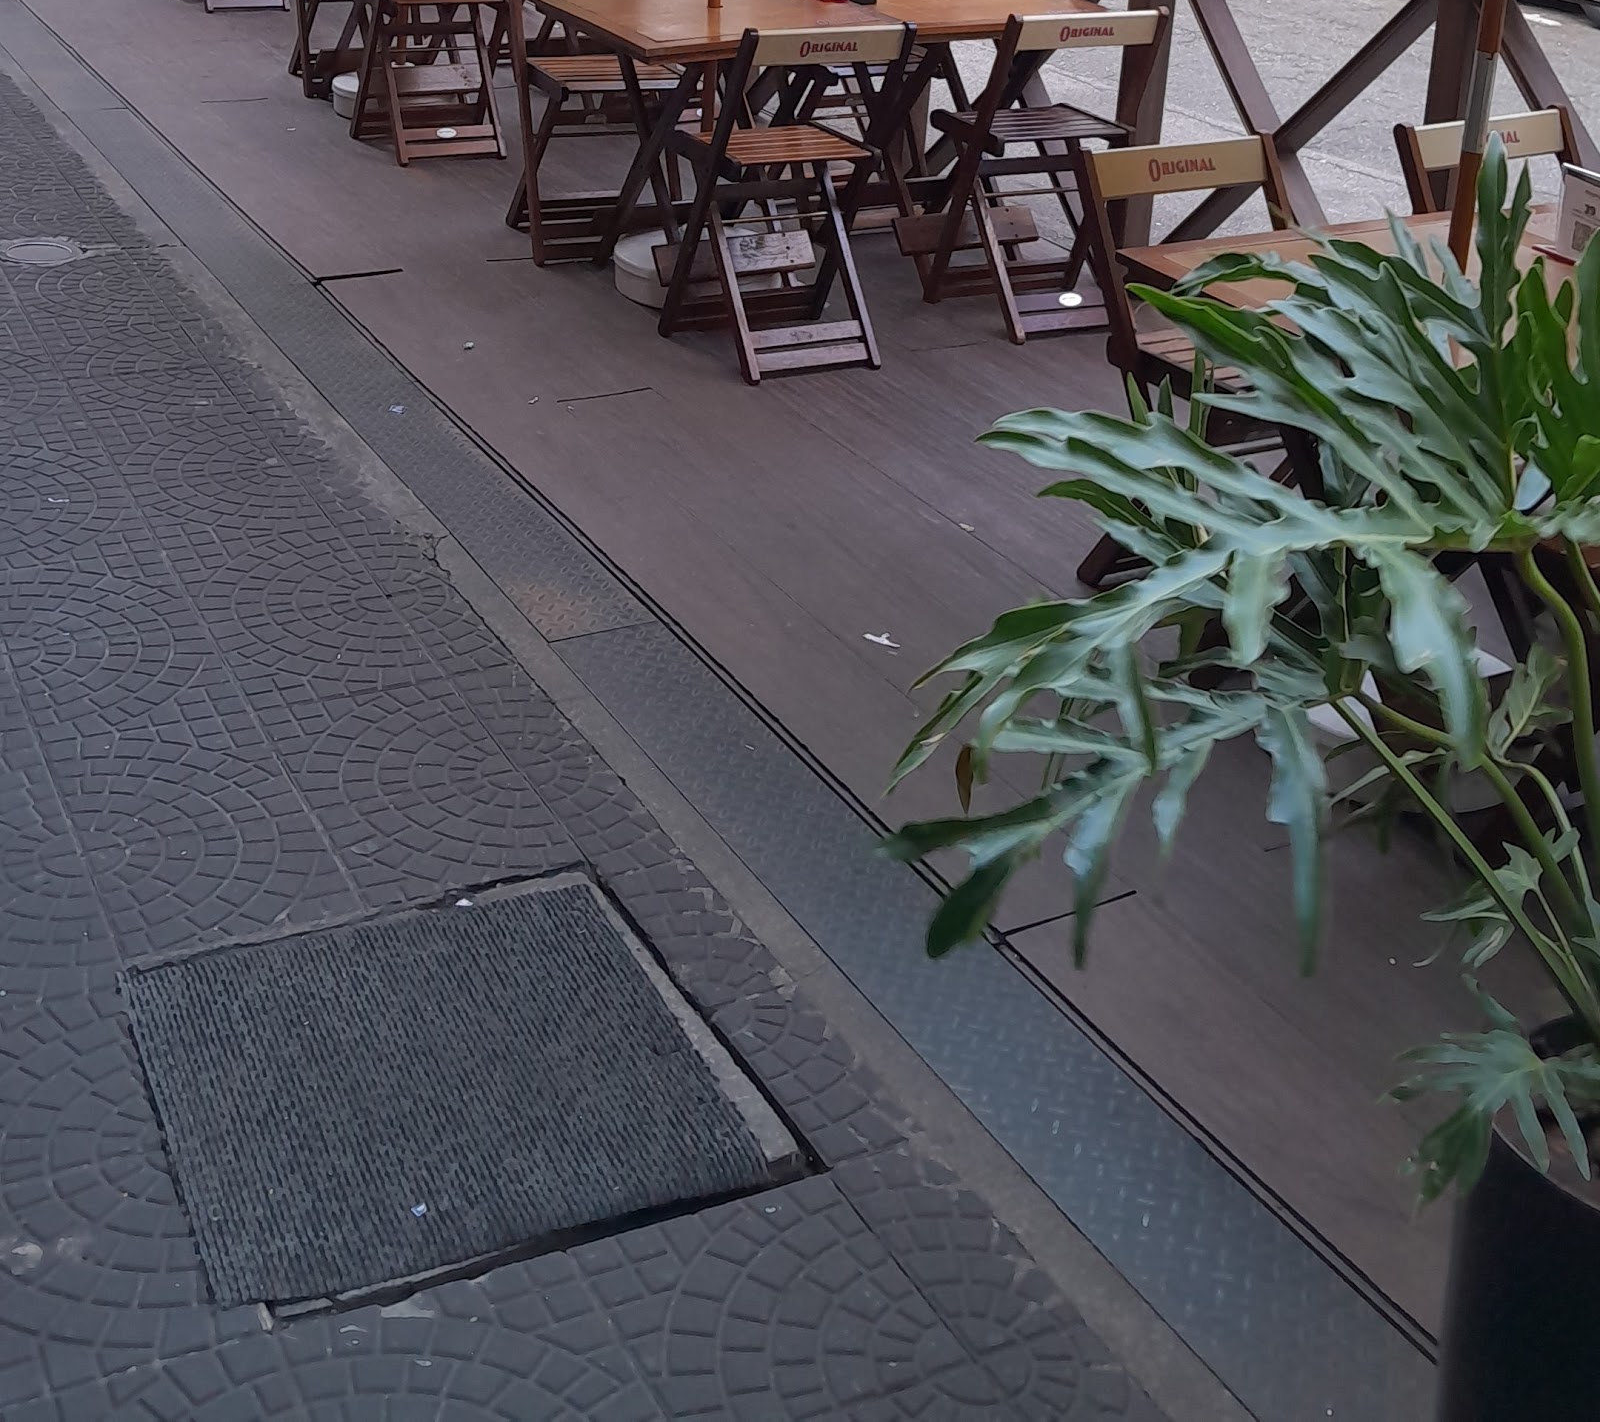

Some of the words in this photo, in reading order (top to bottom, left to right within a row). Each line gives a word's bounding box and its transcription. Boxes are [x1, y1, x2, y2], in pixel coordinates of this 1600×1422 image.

[1059, 25, 1115, 43] ORIGINAL
[800, 40, 859, 58] ORIGINAL
[1148, 157, 1217, 183] ORIGINAL
